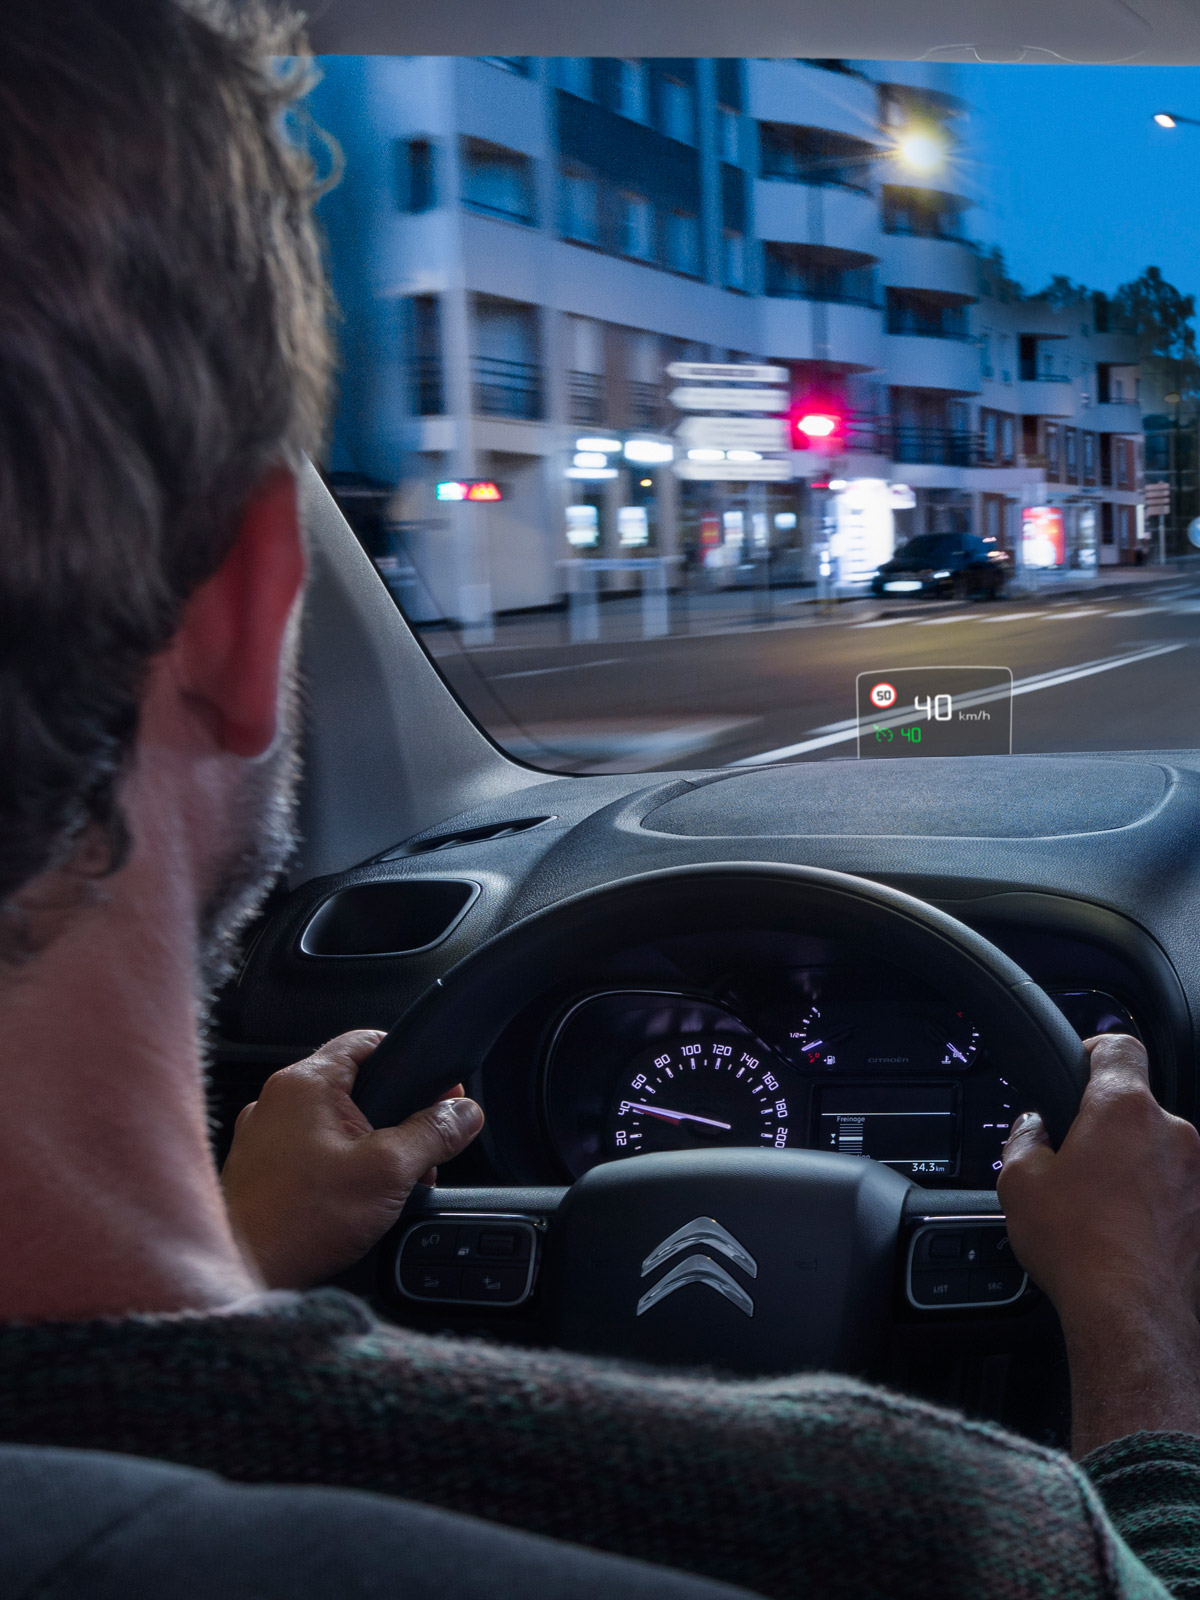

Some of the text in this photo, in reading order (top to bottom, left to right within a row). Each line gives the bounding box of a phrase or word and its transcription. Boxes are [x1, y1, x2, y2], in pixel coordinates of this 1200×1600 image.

[876, 690, 892, 701] 50
[914, 694, 991, 721] 40 km/h
[901, 727, 922, 743] 40
[680, 1043, 702, 1057] 100
[712, 1043, 733, 1057] 120
[653, 1053, 671, 1069] 80
[739, 1052, 760, 1069] 140
[630, 1073, 648, 1090] 60
[761, 1071, 779, 1091] 160
[617, 1100, 631, 1116] 40
[774, 1098, 788, 1119] 180
[616, 1130, 627, 1147] 20
[774, 1127, 788, 1149] 200
[933, 1285, 949, 1293] LIST
